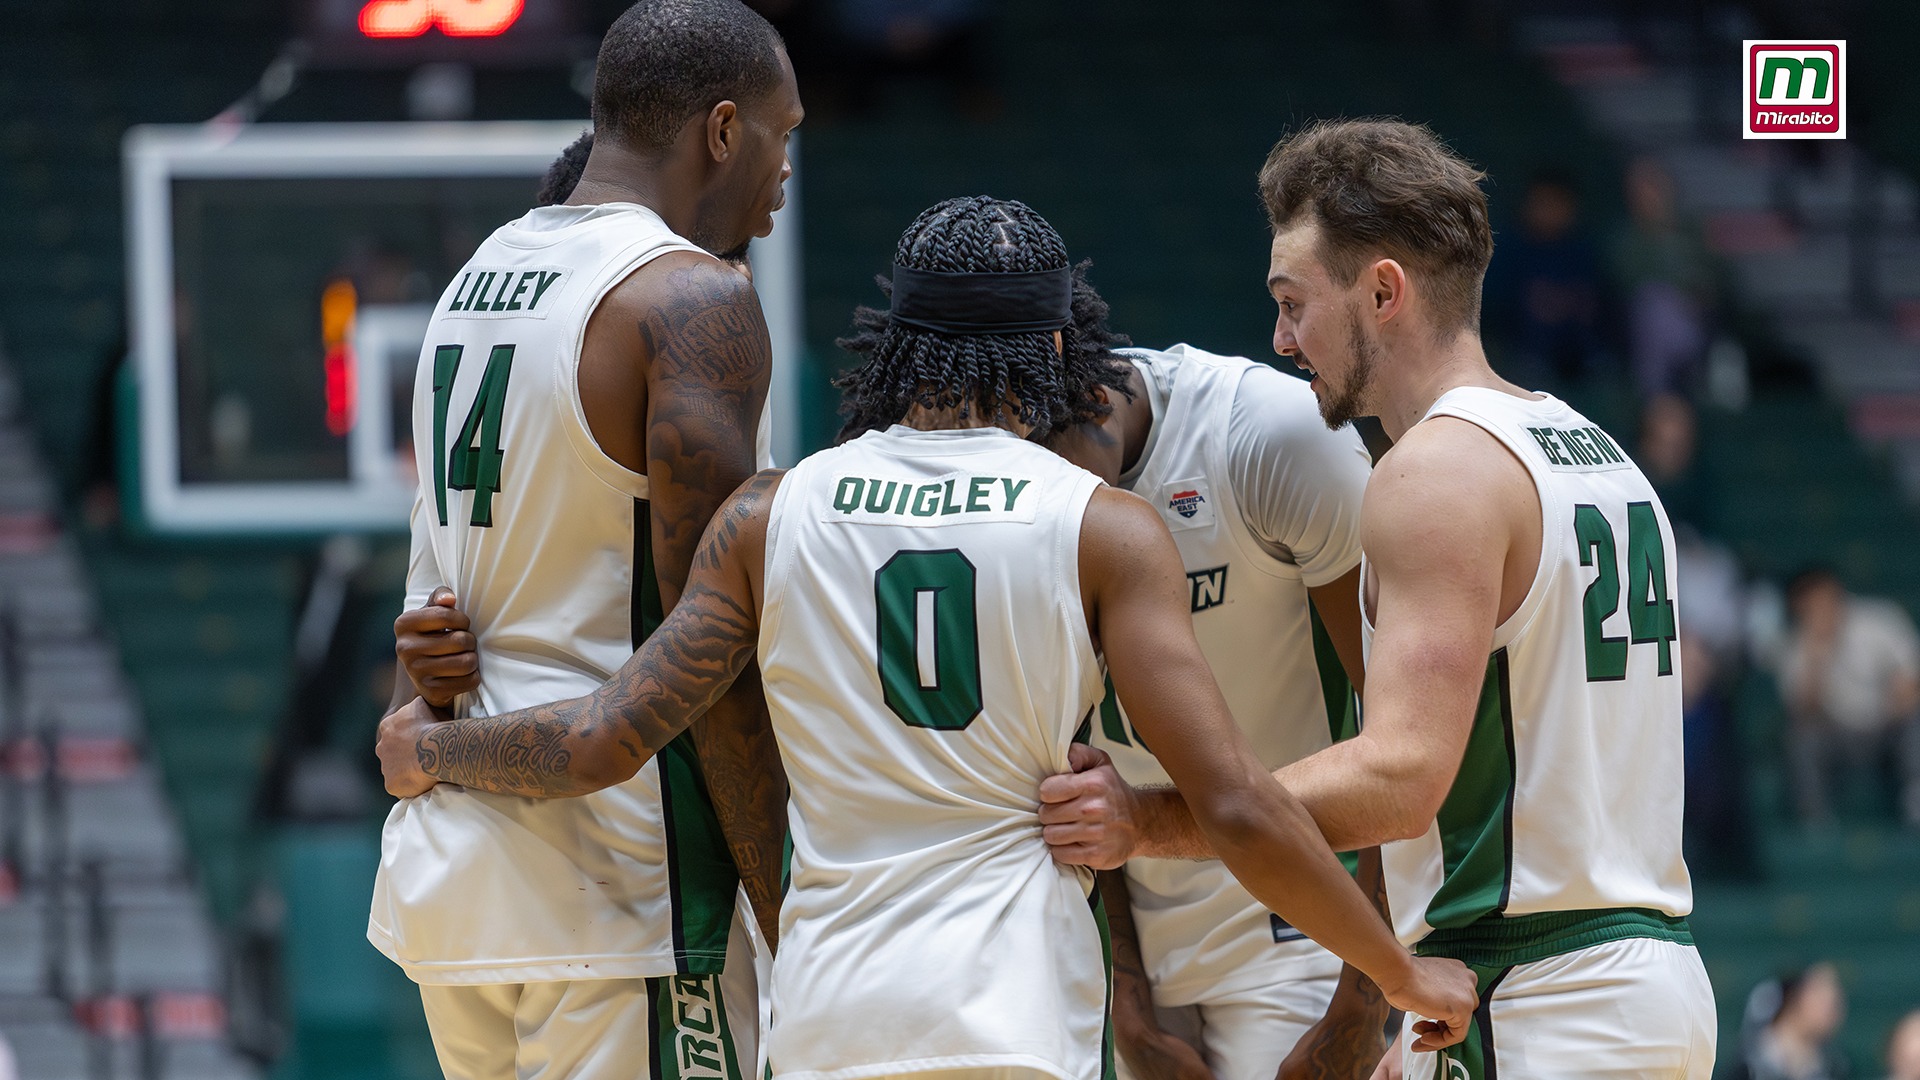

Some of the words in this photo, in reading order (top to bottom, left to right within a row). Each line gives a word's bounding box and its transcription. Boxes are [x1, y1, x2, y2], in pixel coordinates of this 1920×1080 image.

[448, 270, 562, 312] LILLEY
[432, 343, 517, 528] 14
[832, 476, 1032, 517] QUIGLEY
[1169, 495, 1206, 509] AMERICA
[1177, 502, 1198, 512] EAST
[1186, 562, 1230, 613] N
[1573, 500, 1677, 682] 24
[874, 547, 984, 731] 0
[668, 973, 728, 1080] RCA
